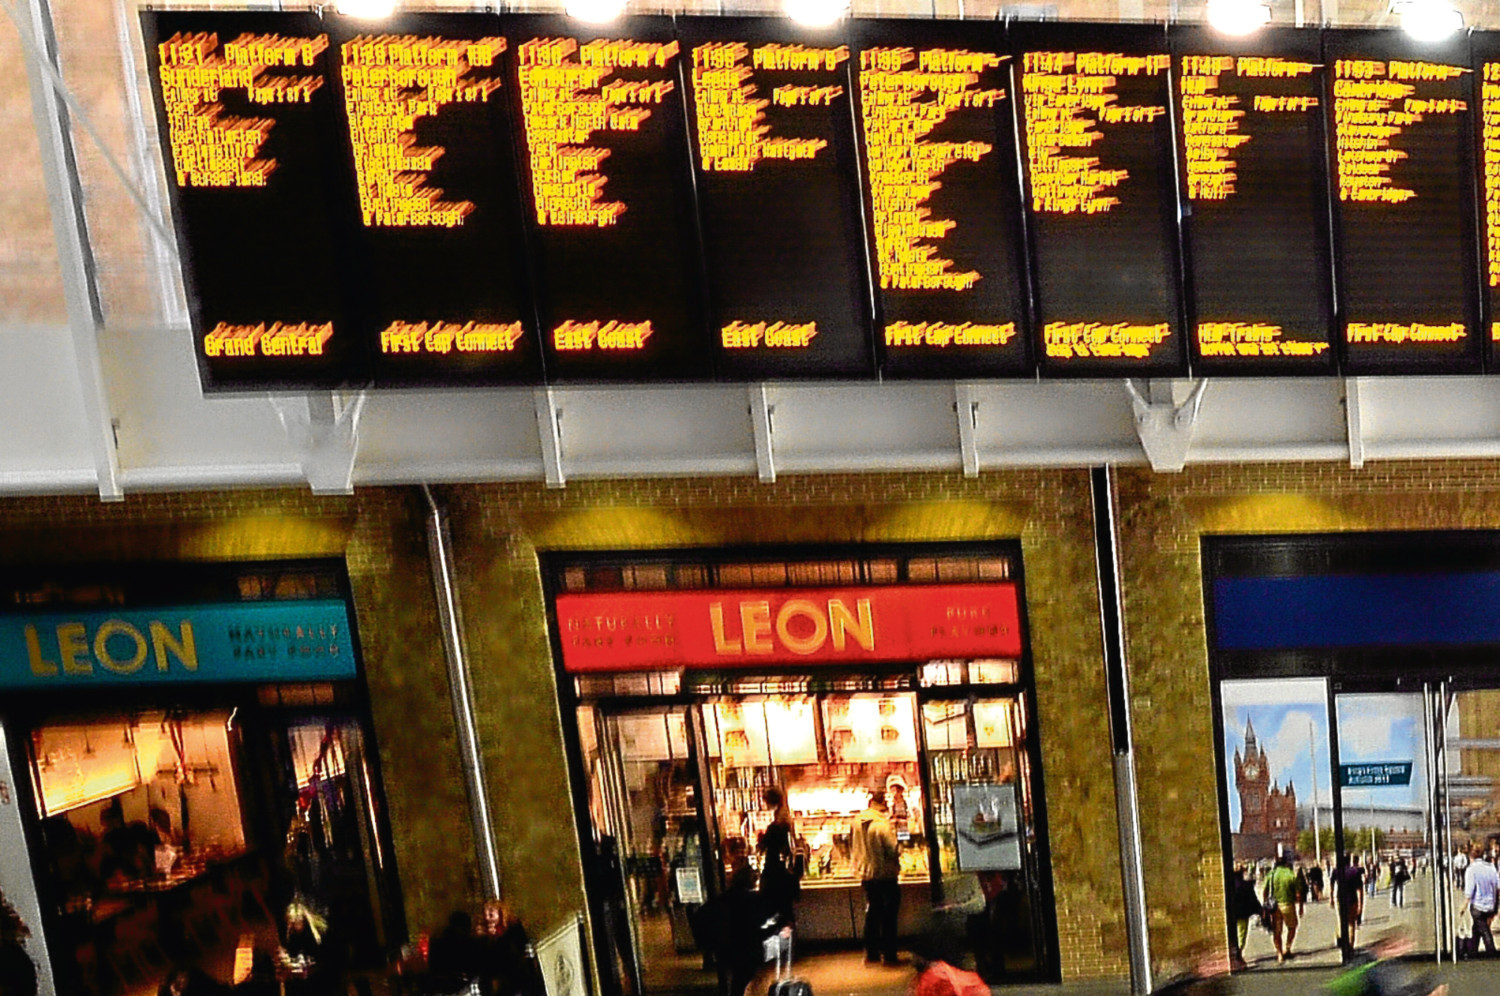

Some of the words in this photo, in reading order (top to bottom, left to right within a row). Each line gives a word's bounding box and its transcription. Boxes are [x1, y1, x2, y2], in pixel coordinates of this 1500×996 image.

[919, 51, 984, 72] Platform
[1075, 53, 1143, 75] Platform
[1237, 56, 1298, 77] Platform
[1389, 61, 1448, 80] Platform
[159, 65, 253, 87] Sunderland
[341, 65, 458, 87] Peterborough
[518, 66, 600, 87] Edinburgh
[692, 68, 740, 88] Leeds
[859, 71, 967, 92] Peterborough
[455, 331, 514, 351] Connect
[554, 328, 593, 350] East
[598, 328, 644, 349] Coast
[722, 327, 759, 348] East
[765, 326, 809, 348] Coast
[885, 325, 922, 346] First
[954, 325, 1008, 344] Connect
[709, 598, 876, 657] LEON
[24, 618, 199, 677] LEON
